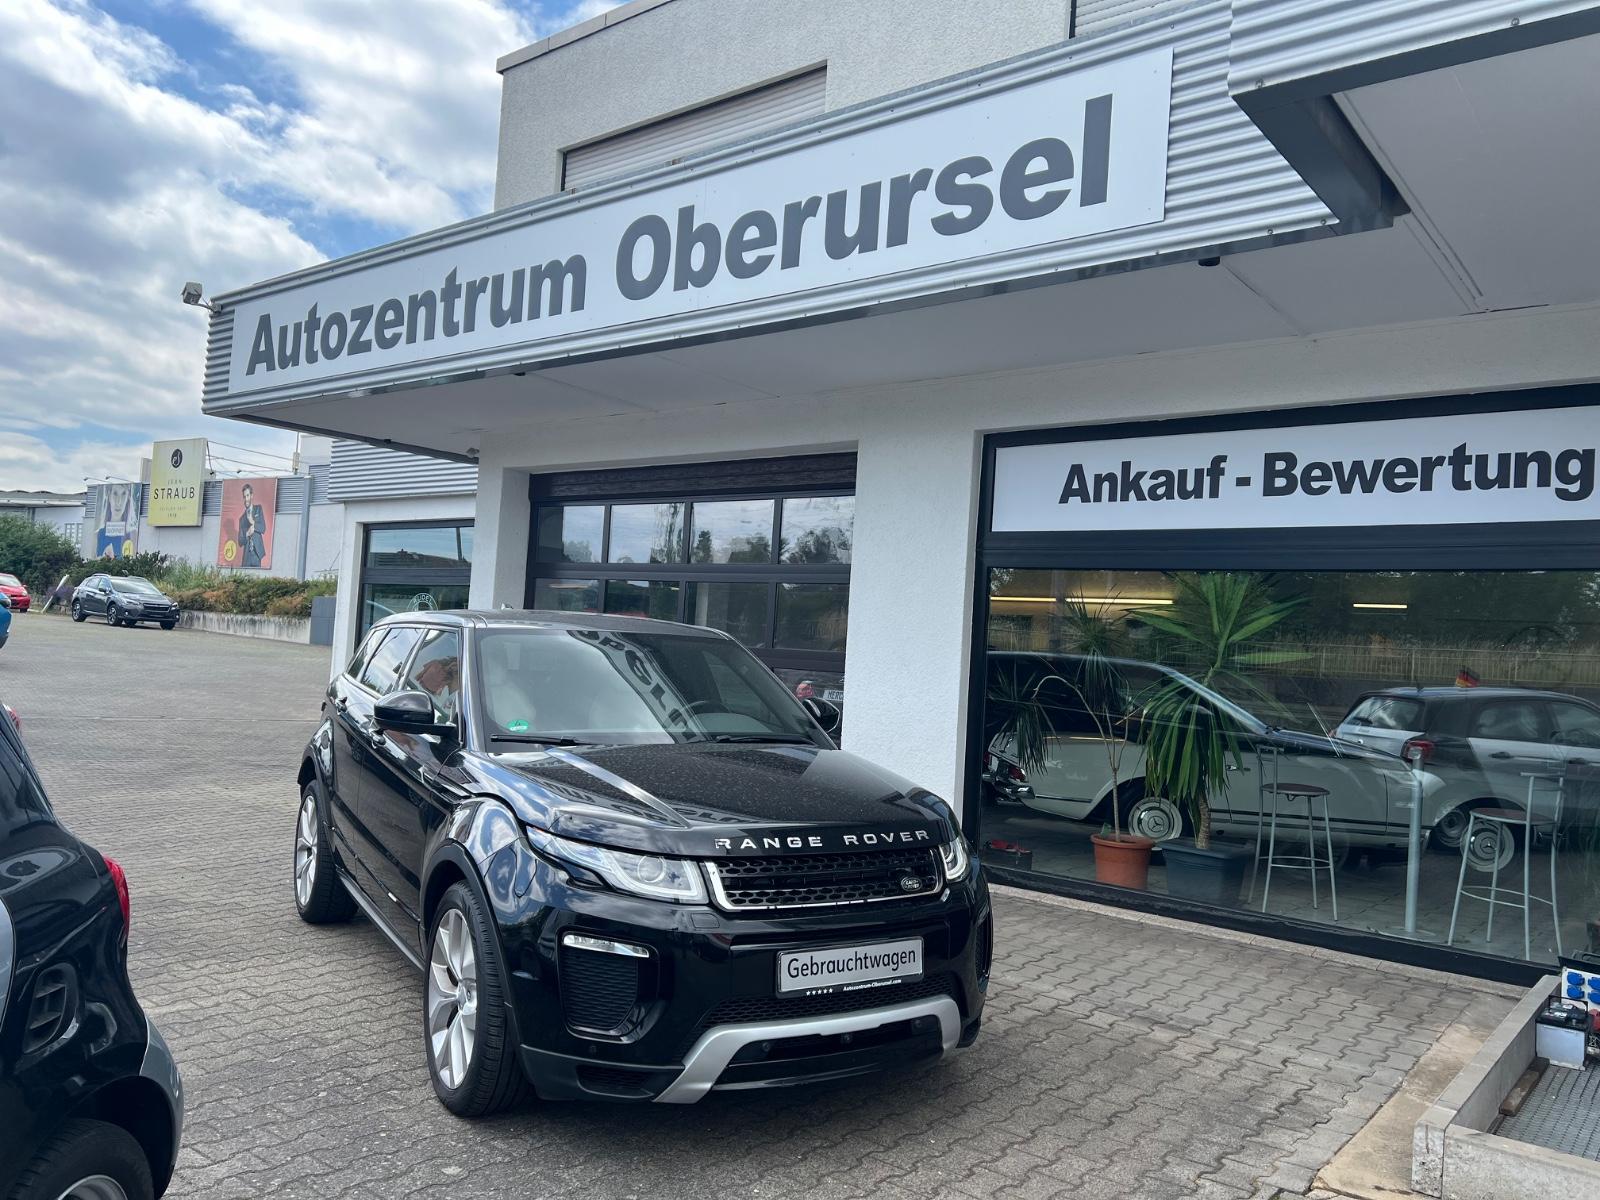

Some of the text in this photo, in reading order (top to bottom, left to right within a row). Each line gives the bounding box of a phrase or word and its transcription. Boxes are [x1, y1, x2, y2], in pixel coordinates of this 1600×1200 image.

[246, 93, 1112, 376] Autozentrum Oberursel
[1058, 454, 1228, 505] Ankauf
[1262, 441, 1596, 502] Bewertung
[153, 486, 195, 500] STRAUB
[715, 830, 930, 850] RANGE ROVER
[787, 950, 916, 979] Gebrauchtwagen
